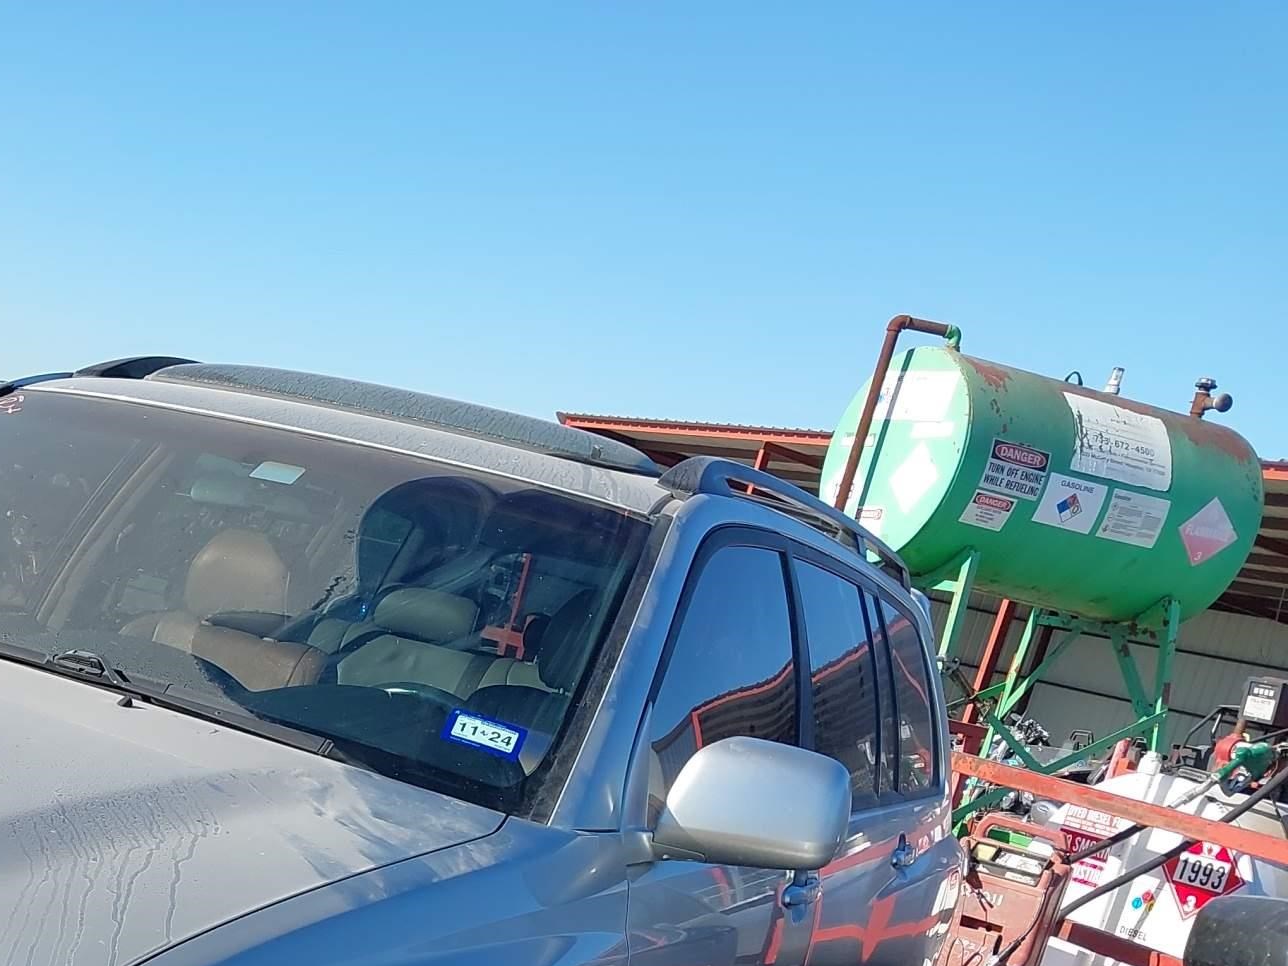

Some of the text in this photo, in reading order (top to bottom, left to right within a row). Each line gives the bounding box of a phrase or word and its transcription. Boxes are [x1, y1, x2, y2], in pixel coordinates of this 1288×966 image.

[1000, 446, 1042, 466] DANGER
[988, 462, 1045, 486] TURN OFF ENGINE
[983, 474, 1040, 497] WHILE REFUELING
[1061, 479, 1096, 494] GASOLINE
[978, 495, 1008, 509] DANGER
[1178, 857, 1226, 890] 1993
[1183, 895, 1197, 912] 3
[1119, 925, 1147, 942] DIESEL
